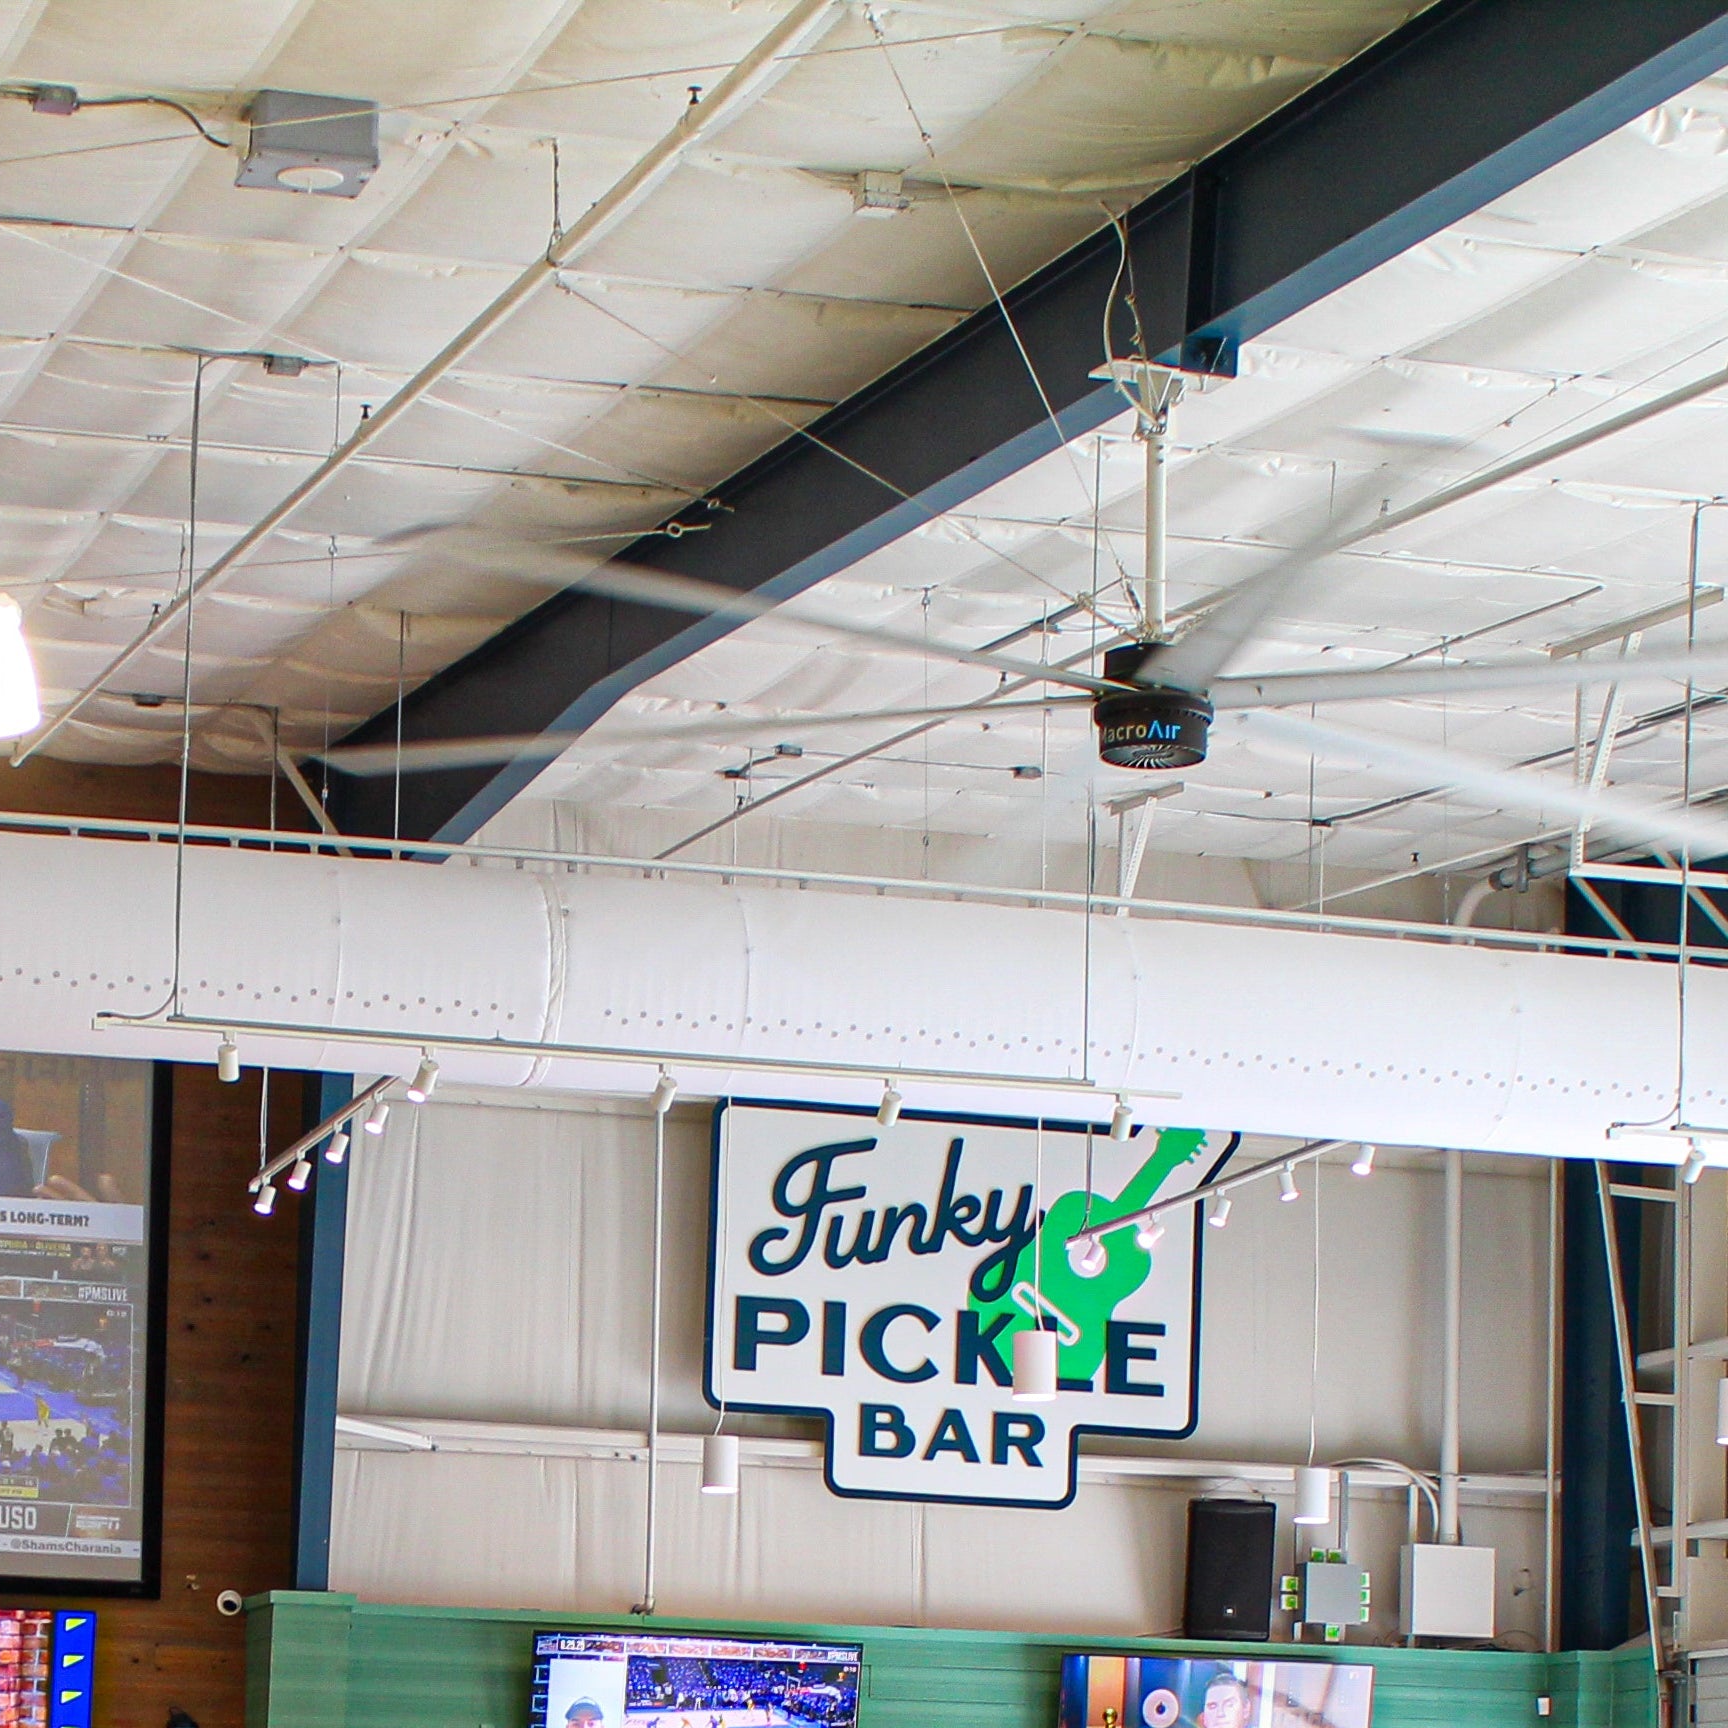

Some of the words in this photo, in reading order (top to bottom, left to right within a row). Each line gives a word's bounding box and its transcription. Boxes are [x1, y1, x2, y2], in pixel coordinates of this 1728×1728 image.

[1103, 719, 1181, 743] acroAir
[10, 1210, 90, 1227] LONG-TERM?
[748, 1137, 1046, 1302] Funky
[858, 1402, 1046, 1467] BAR
